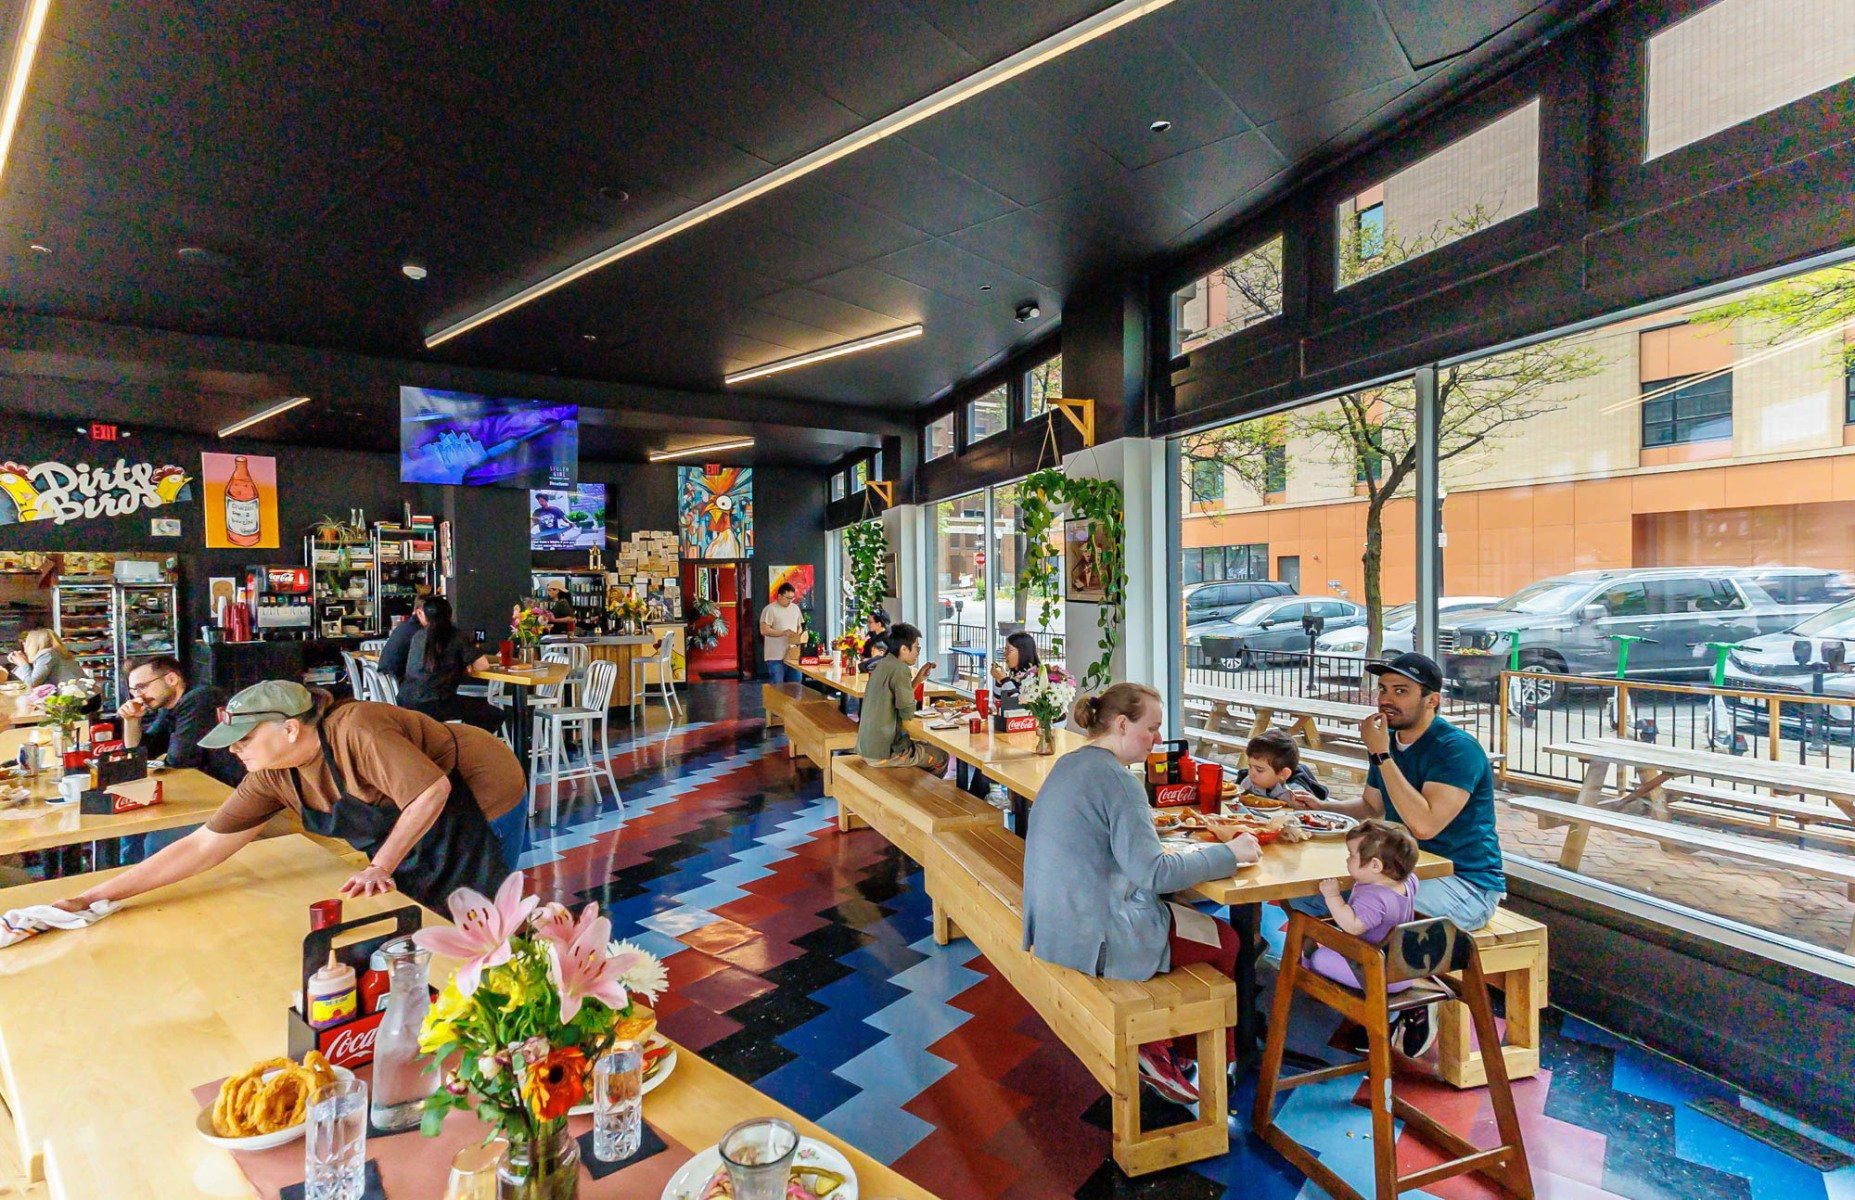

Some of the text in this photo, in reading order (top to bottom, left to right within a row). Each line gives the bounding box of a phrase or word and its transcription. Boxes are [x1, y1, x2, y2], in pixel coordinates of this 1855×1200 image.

[92, 423, 117, 440] EXIT
[27, 458, 153, 498] Dirty
[34, 485, 162, 525] Birds
[475, 631, 485, 641] 74
